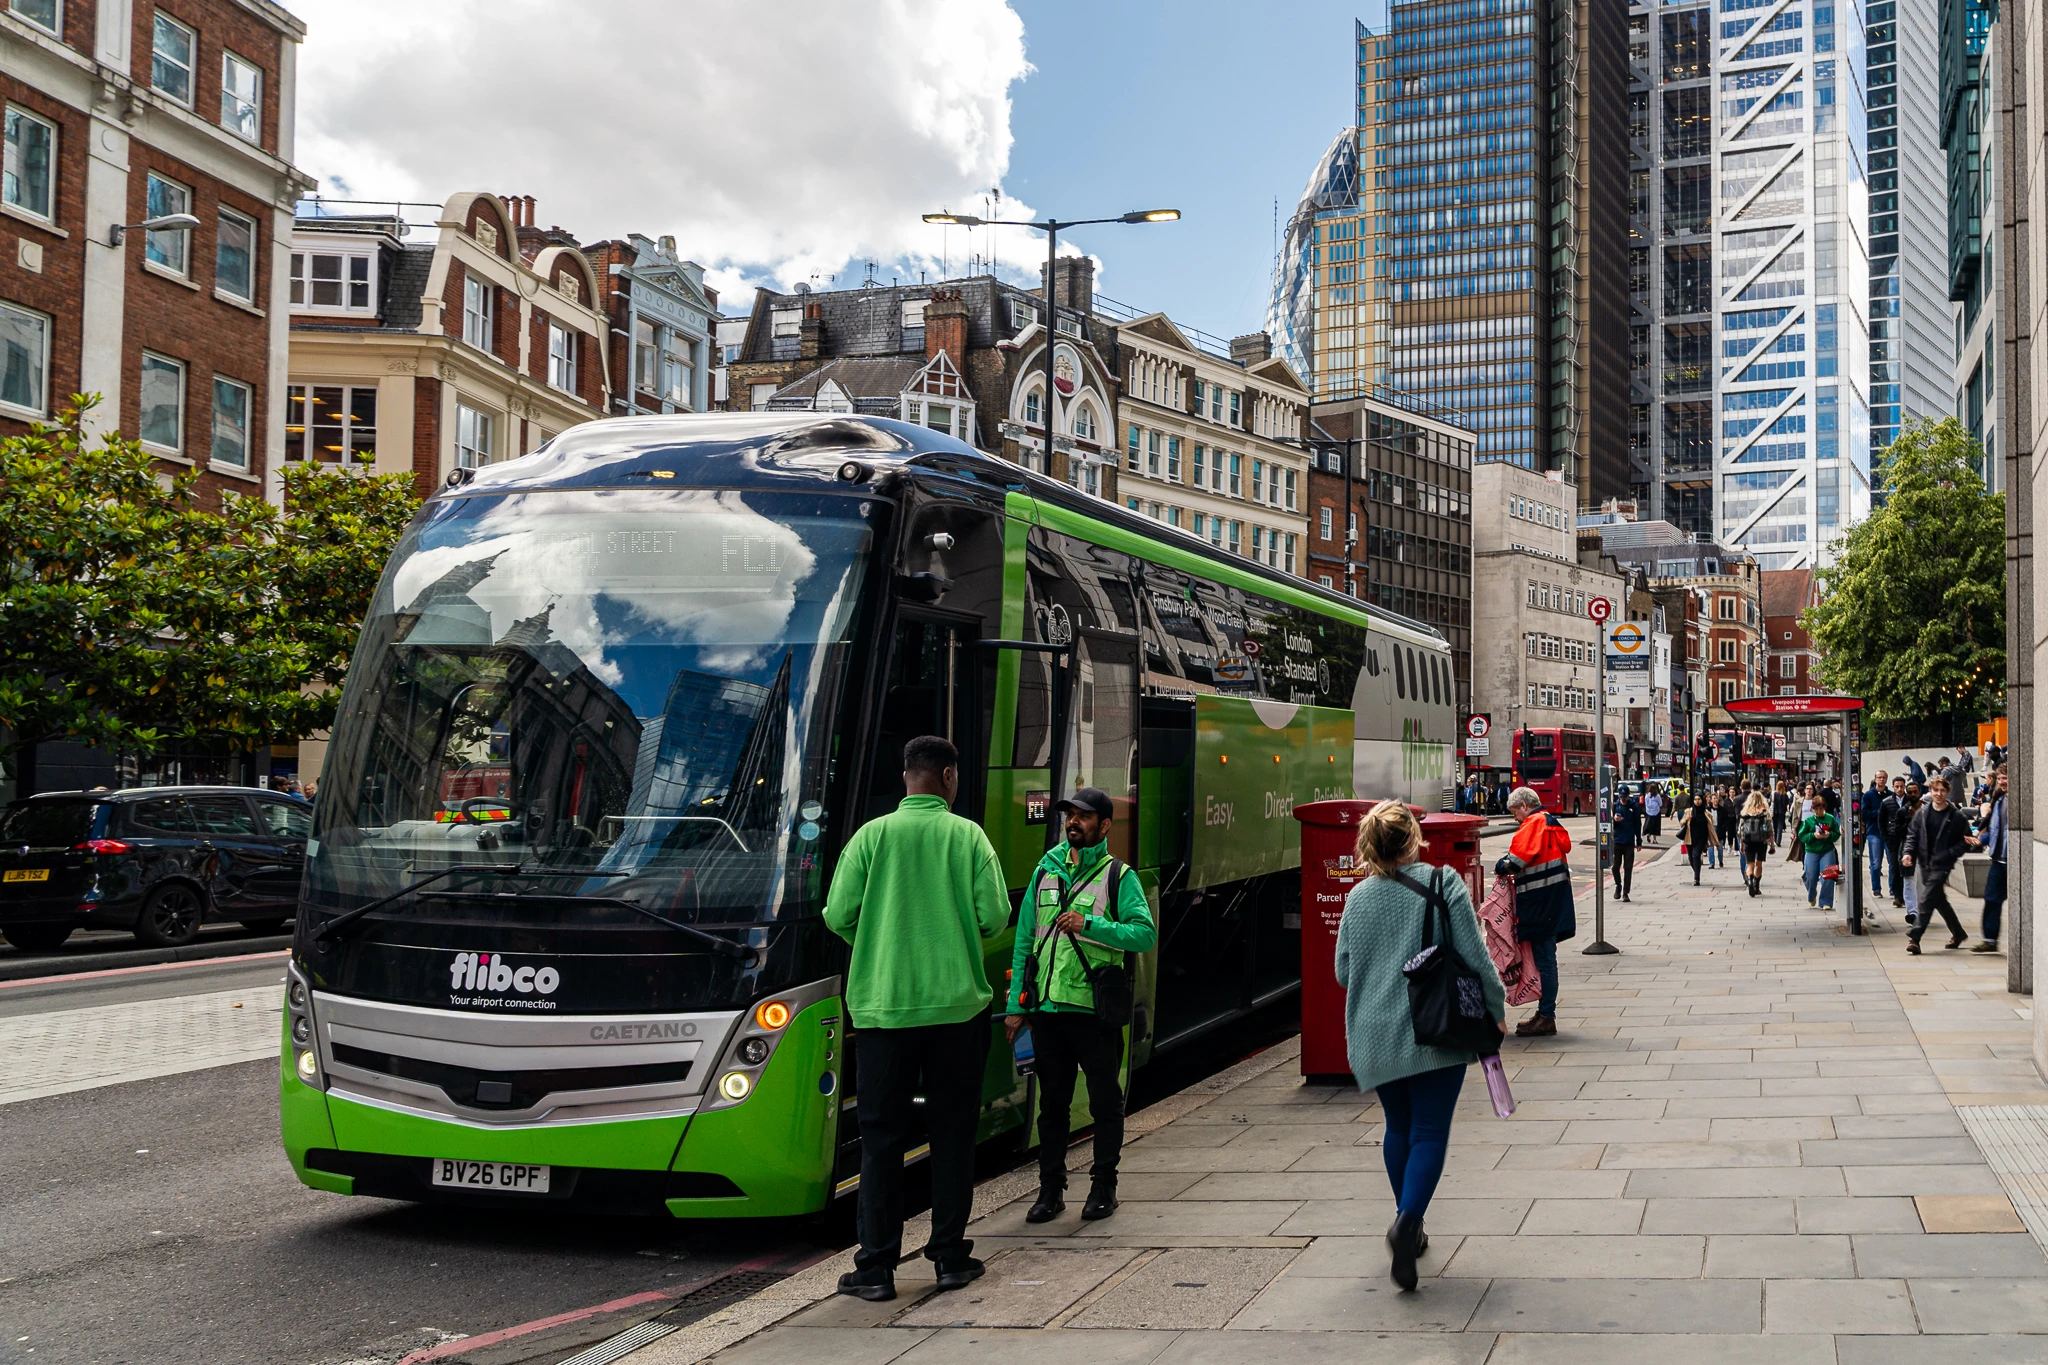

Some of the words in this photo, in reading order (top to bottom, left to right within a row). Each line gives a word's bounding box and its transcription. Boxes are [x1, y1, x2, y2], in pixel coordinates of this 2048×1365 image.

[607, 531, 678, 553] STREET
[1153, 592, 1184, 618] Finsbury
[1184, 600, 1200, 619] Park
[1206, 605, 1225, 625] Wood
[1226, 612, 1244, 629] Green
[1591, 600, 1606, 618] G
[1284, 627, 1313, 654] London
[1284, 656, 1318, 682] Stansted
[1402, 717, 1444, 782] flibco
[1205, 795, 1235, 831] Easy.
[1329, 869, 1348, 878] Royal
[1349, 869, 1365, 877] Mail
[1316, 892, 1342, 902] Parcel
[450, 952, 560, 994] flibco
[450, 995, 471, 1006] Your
[472, 996, 503, 1008] airport
[505, 998, 557, 1010] connection
[590, 1022, 698, 1040] CAETANO
[441, 1160, 494, 1184] BV26
[500, 1164, 542, 1188] GPF
